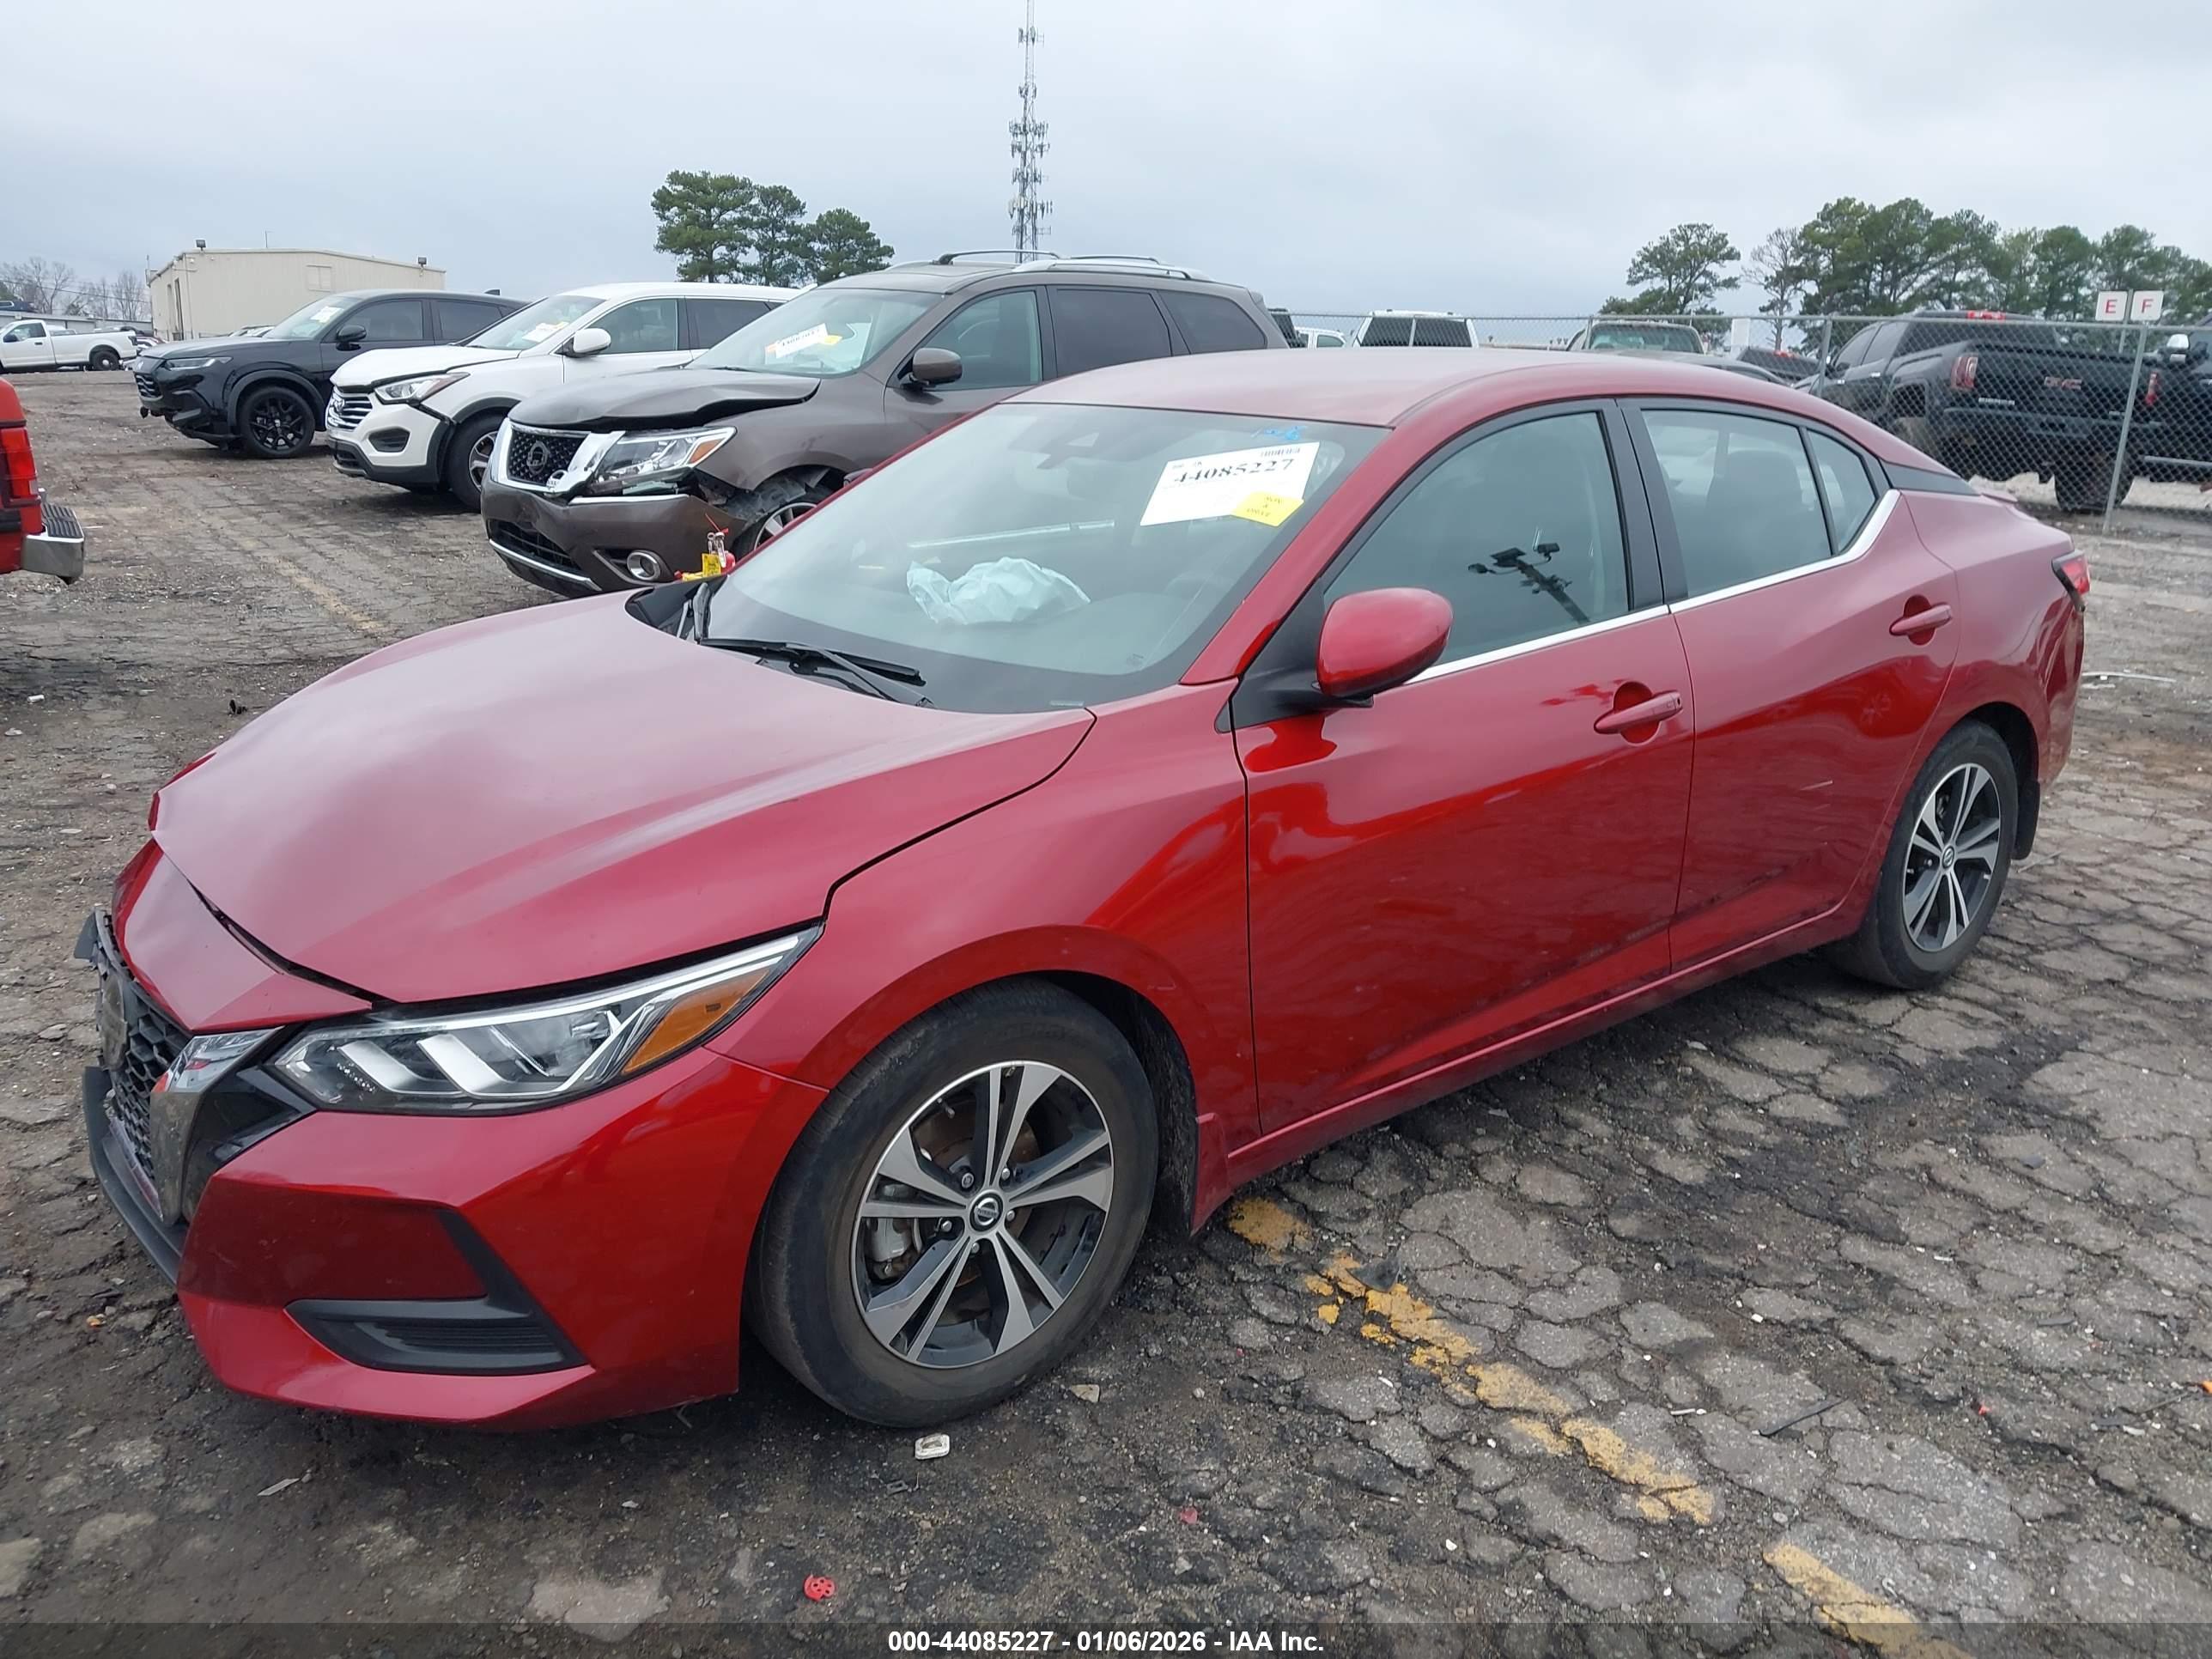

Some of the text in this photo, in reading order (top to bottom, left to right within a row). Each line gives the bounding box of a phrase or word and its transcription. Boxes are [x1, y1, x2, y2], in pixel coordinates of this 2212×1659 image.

[2105, 299, 2118, 314] E
[2141, 298, 2154, 313] F
[1173, 458, 1295, 483] 44085227
